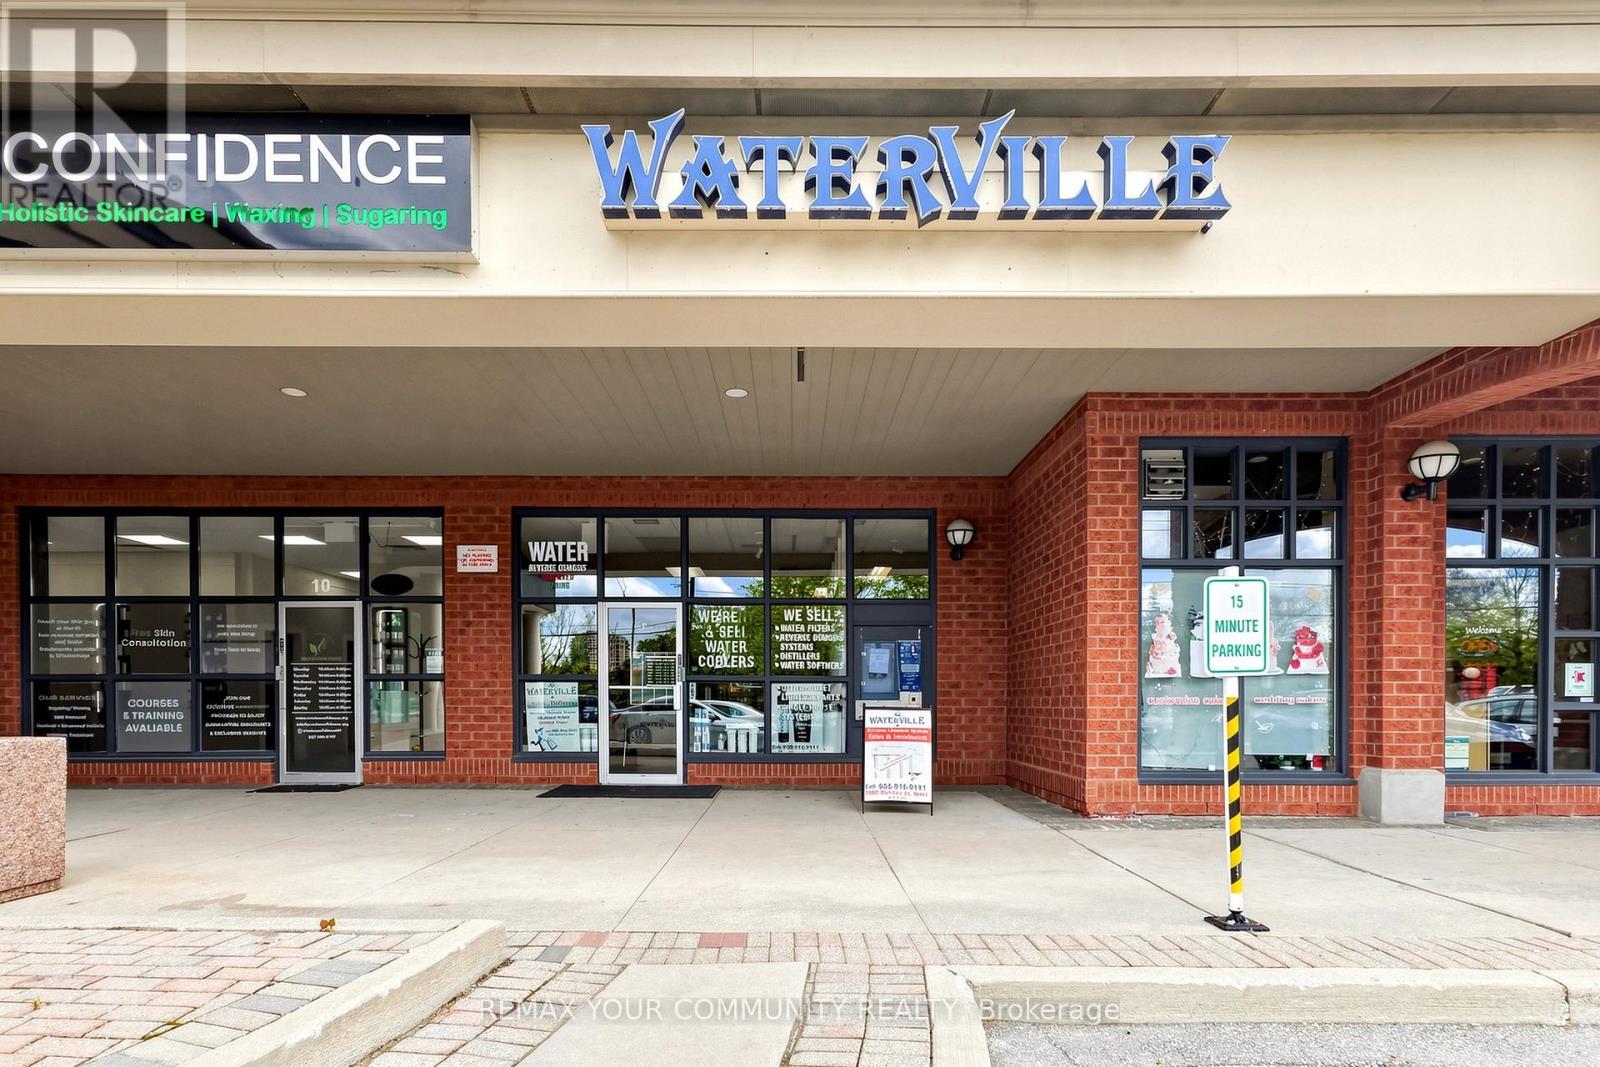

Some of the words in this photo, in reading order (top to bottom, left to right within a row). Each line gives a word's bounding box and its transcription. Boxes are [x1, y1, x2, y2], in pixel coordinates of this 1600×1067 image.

[3, 132, 446, 185] CONFIDENCE
[580, 108, 1232, 226] WATERVILLE
[0, 202, 89, 222] Holistic
[97, 201, 205, 222] Skincare
[226, 203, 315, 230] Waxing
[336, 204, 447, 230] Sugaring
[528, 542, 589, 562] WATER
[312, 579, 330, 593] 10
[1231, 595, 1243, 608] 15
[784, 609, 803, 621] WE
[780, 624, 805, 632] WATER
[1215, 619, 1259, 632] MINUTE
[154, 629, 175, 637] Skin
[121, 639, 187, 647] Consultation
[705, 640, 748, 653] WATER
[780, 643, 814, 651] SYSTEMS
[1212, 644, 1262, 657] PARKING
[698, 655, 755, 668] COOLERS
[780, 661, 805, 669] WATER
[127, 699, 179, 708] COURSES
[123, 711, 130, 720] &
[132, 711, 184, 720] TRAINING
[869, 716, 925, 725] WATERVILLE
[125, 724, 183, 732] AVALIABLE
